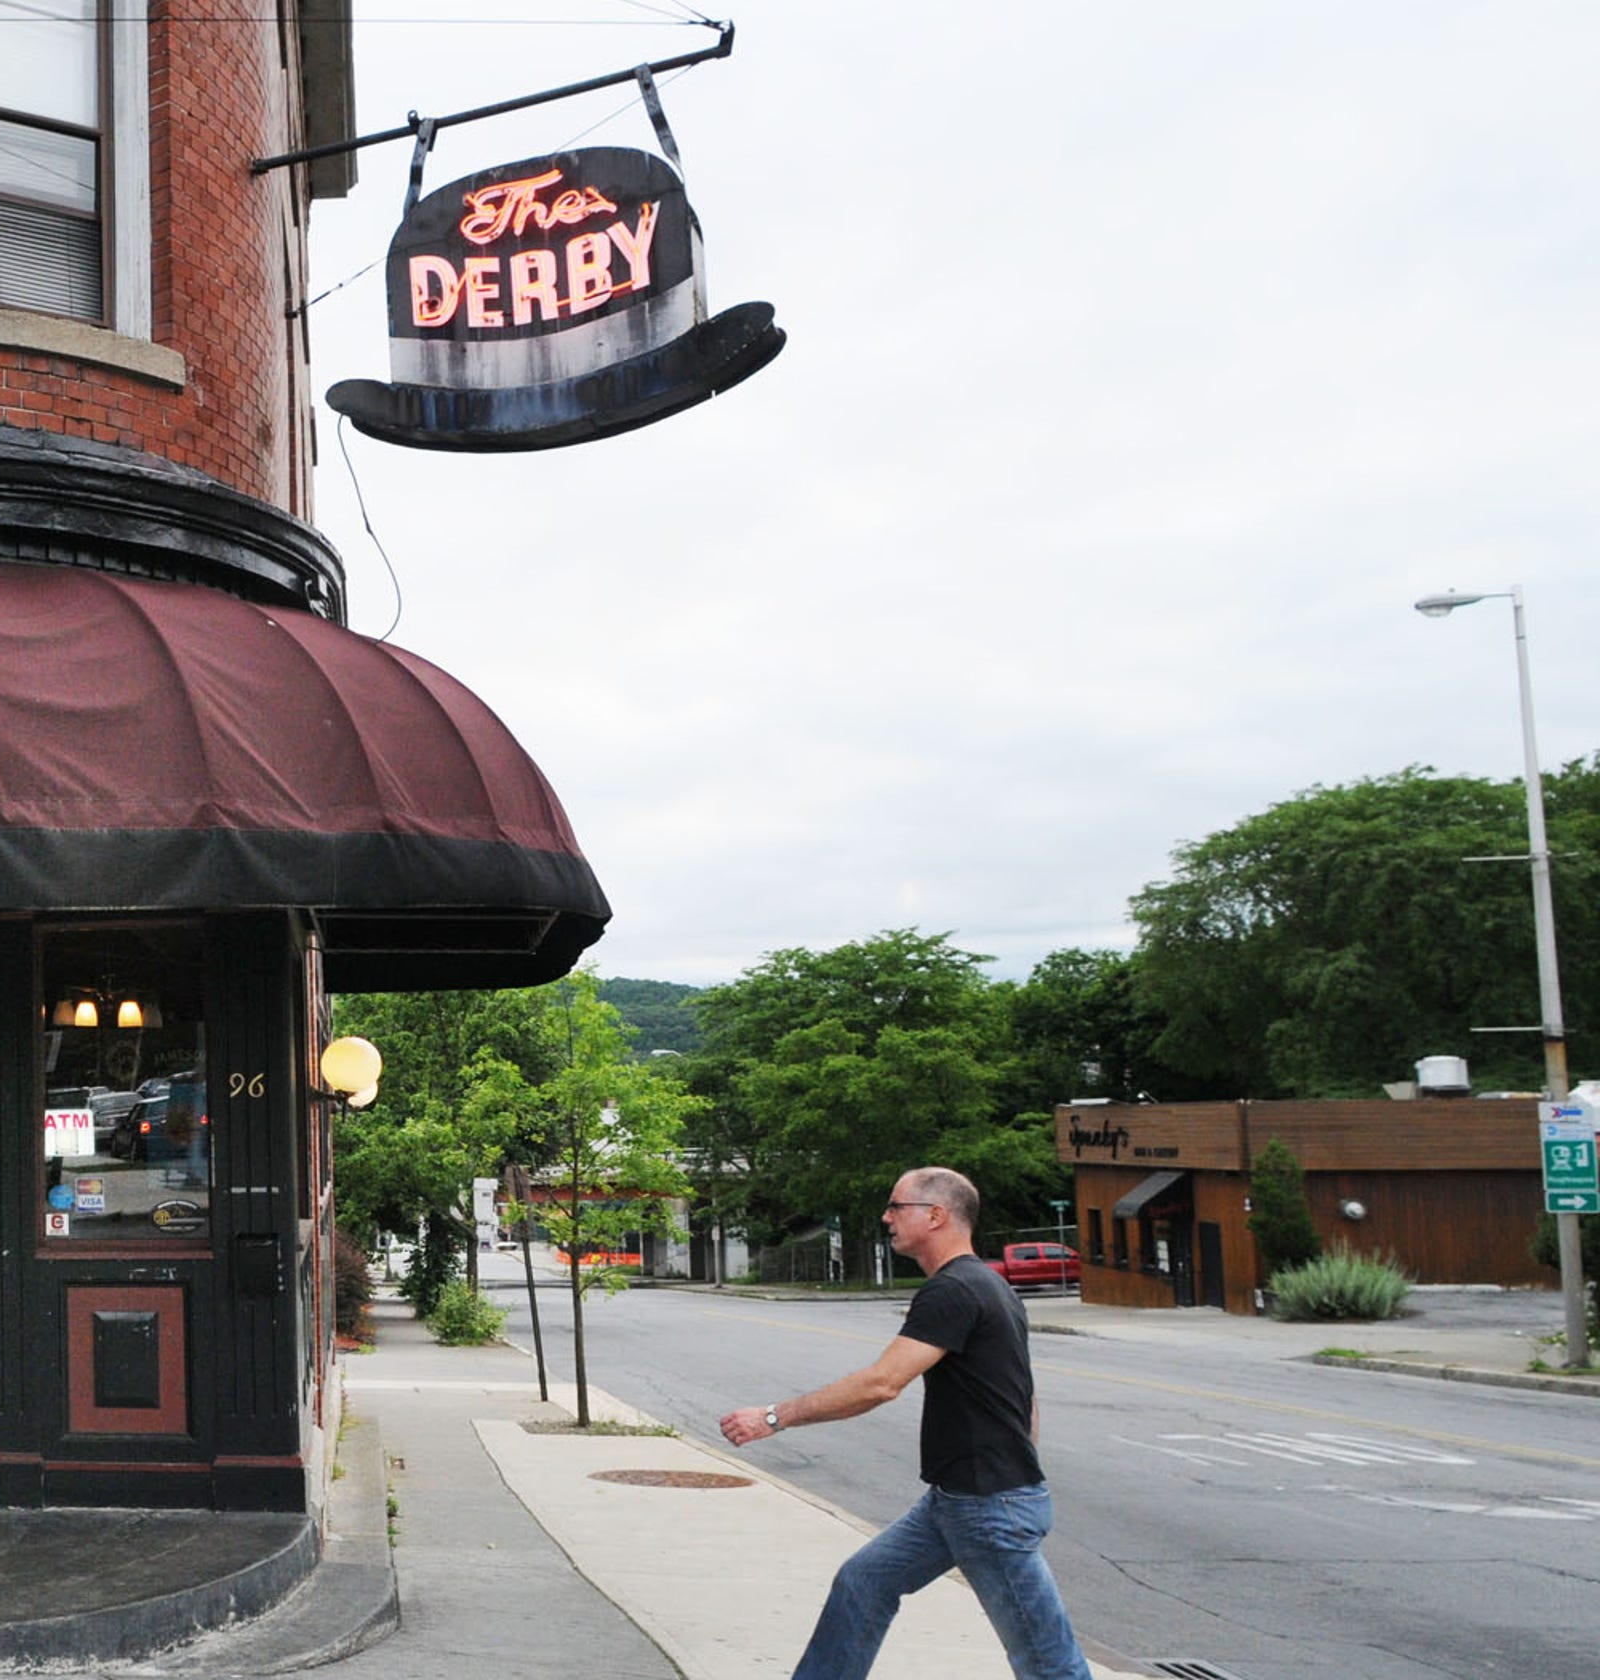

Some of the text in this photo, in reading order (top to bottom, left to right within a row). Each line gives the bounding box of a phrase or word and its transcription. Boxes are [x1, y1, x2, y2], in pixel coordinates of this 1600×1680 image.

[460, 169, 617, 245] The
[409, 201, 660, 328] DERBY
[229, 1073, 265, 1098] 96
[44, 1113, 90, 1130] ATM
[80, 1197, 103, 1206] VISA
